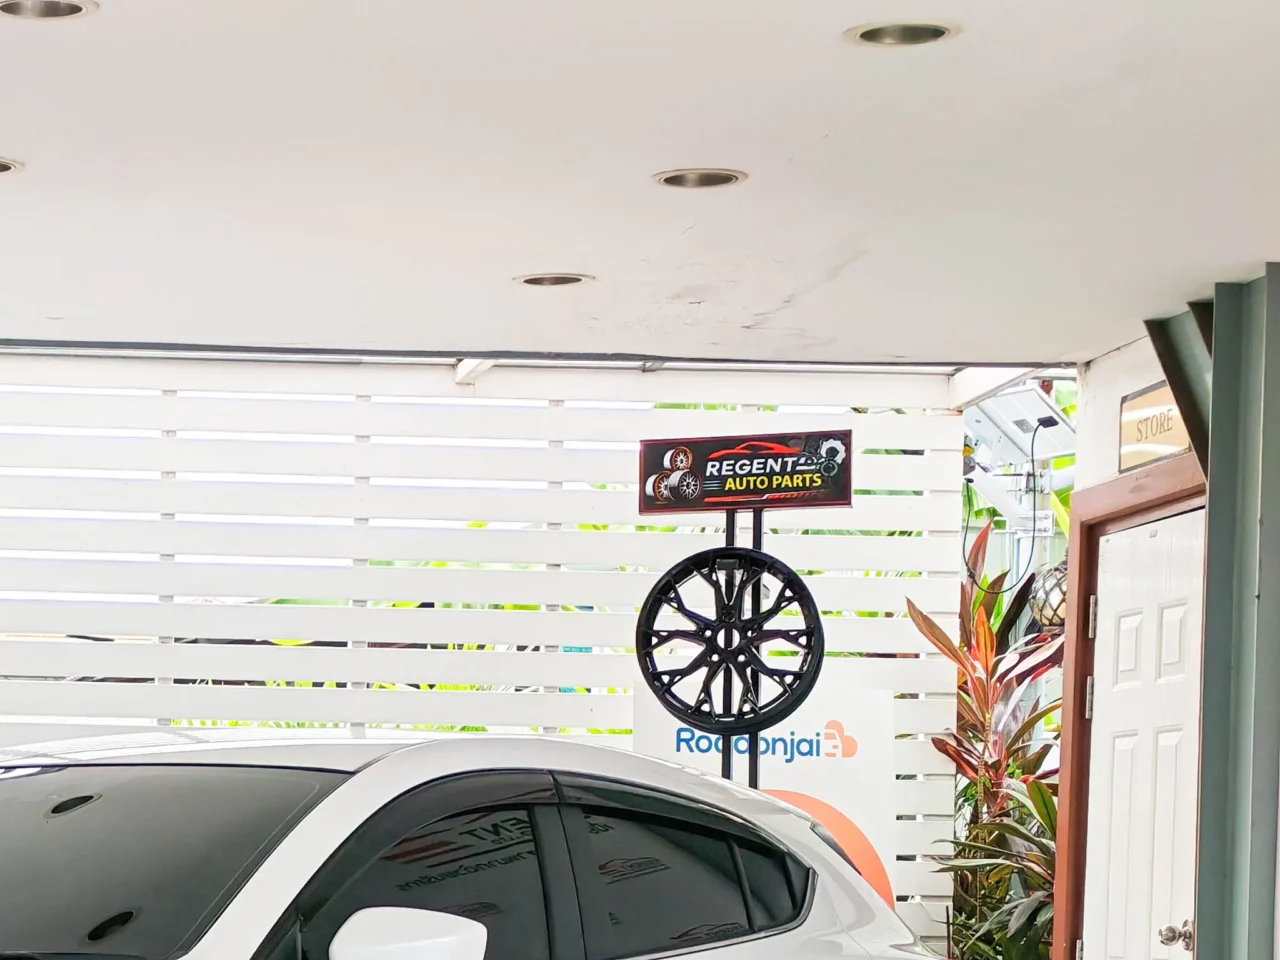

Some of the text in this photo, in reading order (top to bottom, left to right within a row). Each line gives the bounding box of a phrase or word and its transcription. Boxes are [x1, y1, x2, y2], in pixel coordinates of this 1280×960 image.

[1136, 408, 1174, 442] STORE
[705, 456, 798, 477] REGENT
[724, 473, 822, 491] AUTO PARTS
